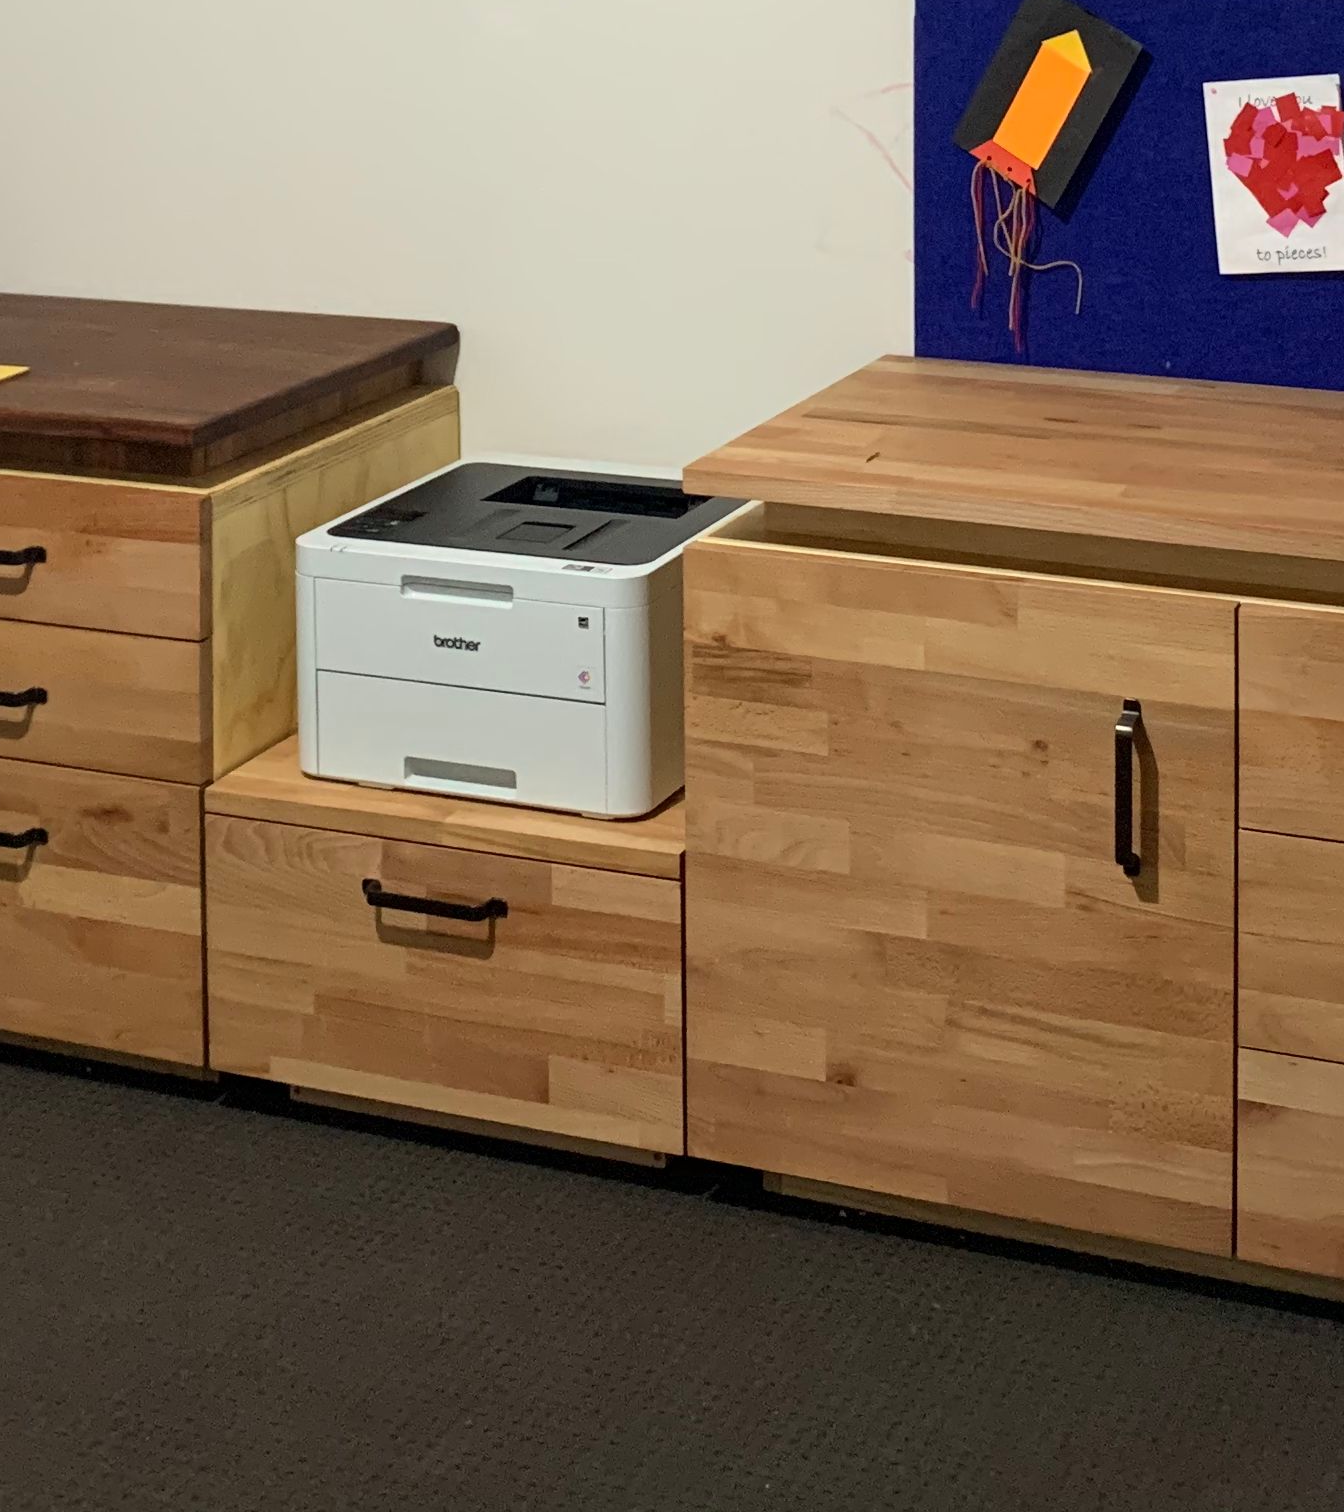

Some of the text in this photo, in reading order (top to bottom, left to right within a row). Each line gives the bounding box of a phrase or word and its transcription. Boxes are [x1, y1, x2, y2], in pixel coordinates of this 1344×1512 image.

[1256, 245, 1327, 265] to pieces!
[433, 634, 481, 651] brother
